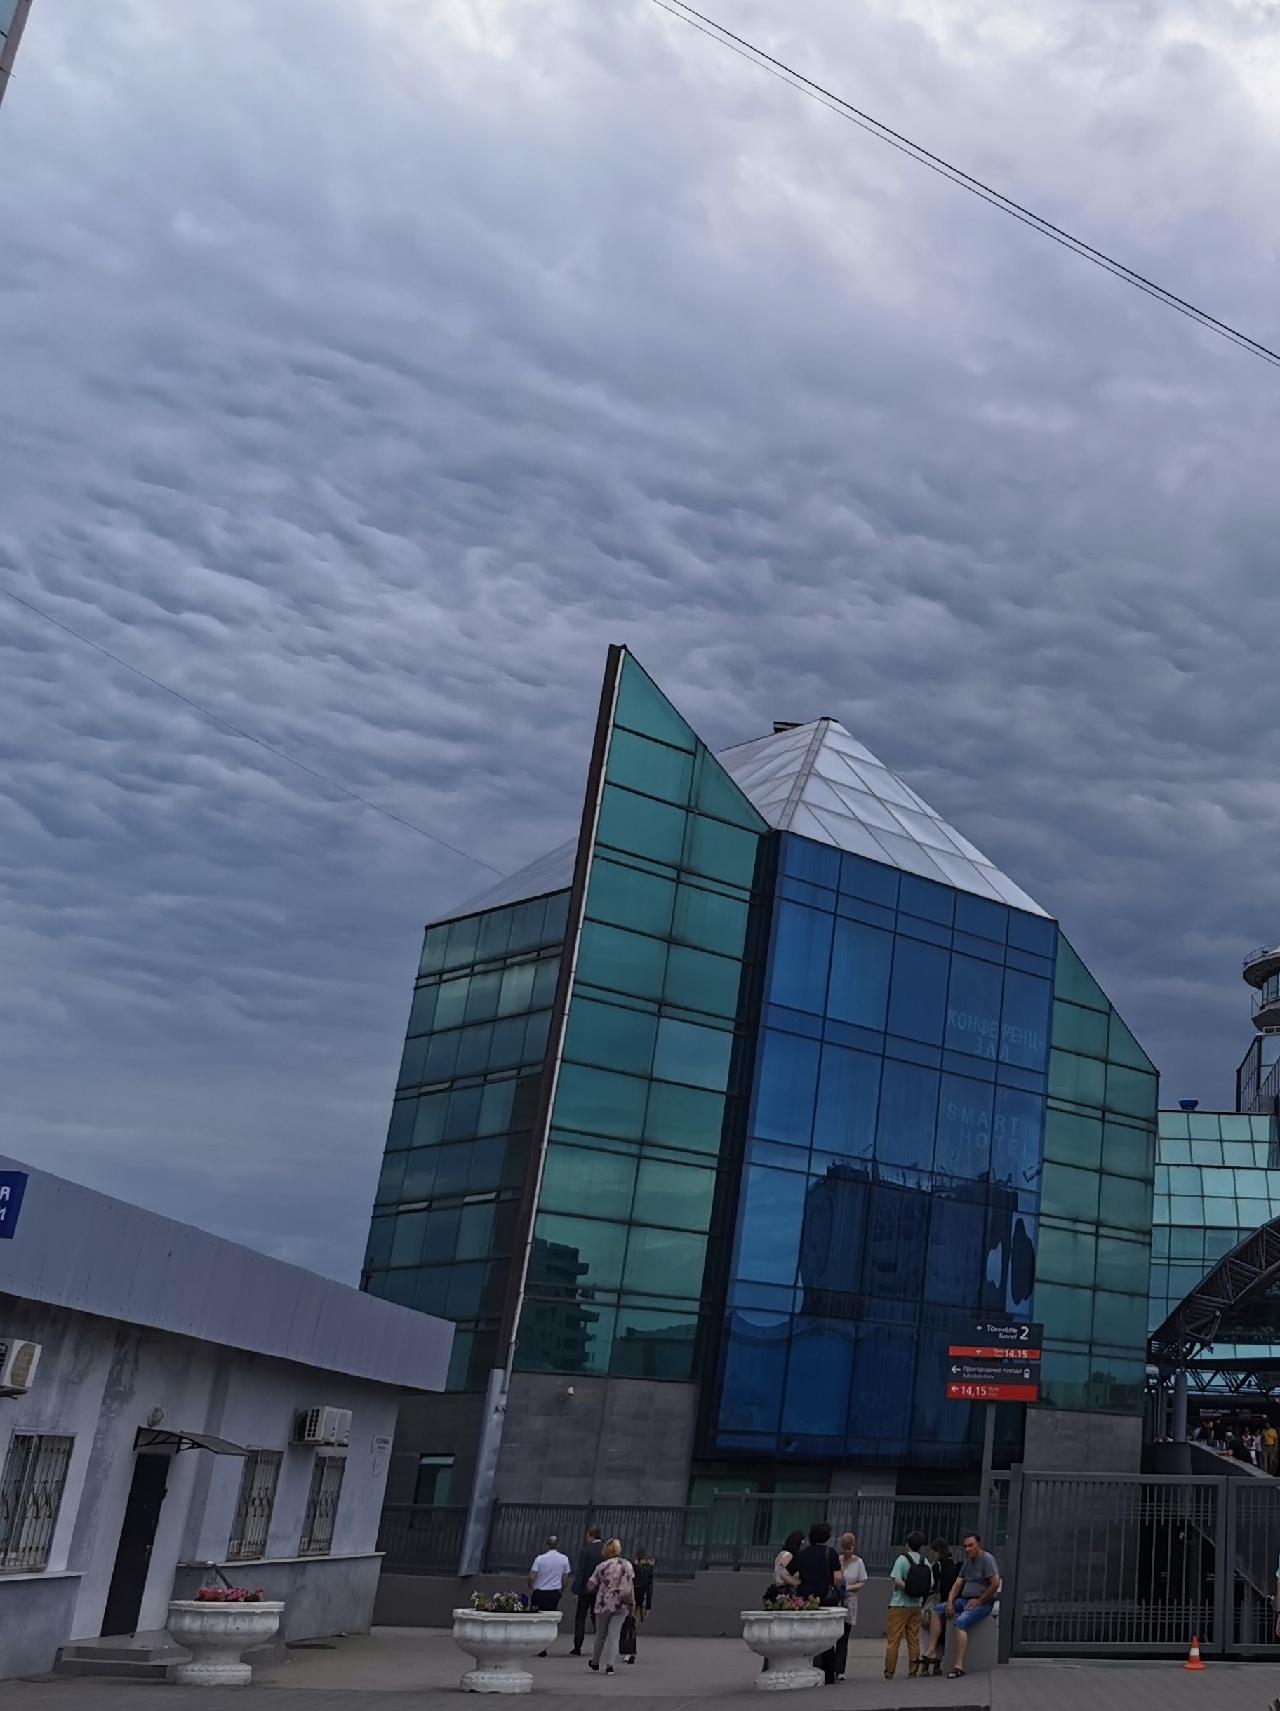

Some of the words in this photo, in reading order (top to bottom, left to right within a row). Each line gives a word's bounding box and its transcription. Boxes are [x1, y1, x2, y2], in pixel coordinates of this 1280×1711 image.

[975, 1036, 1009, 1060] ЗАЛ
[946, 1104, 1020, 1134] SMART
[1020, 1325, 1030, 1340] 2
